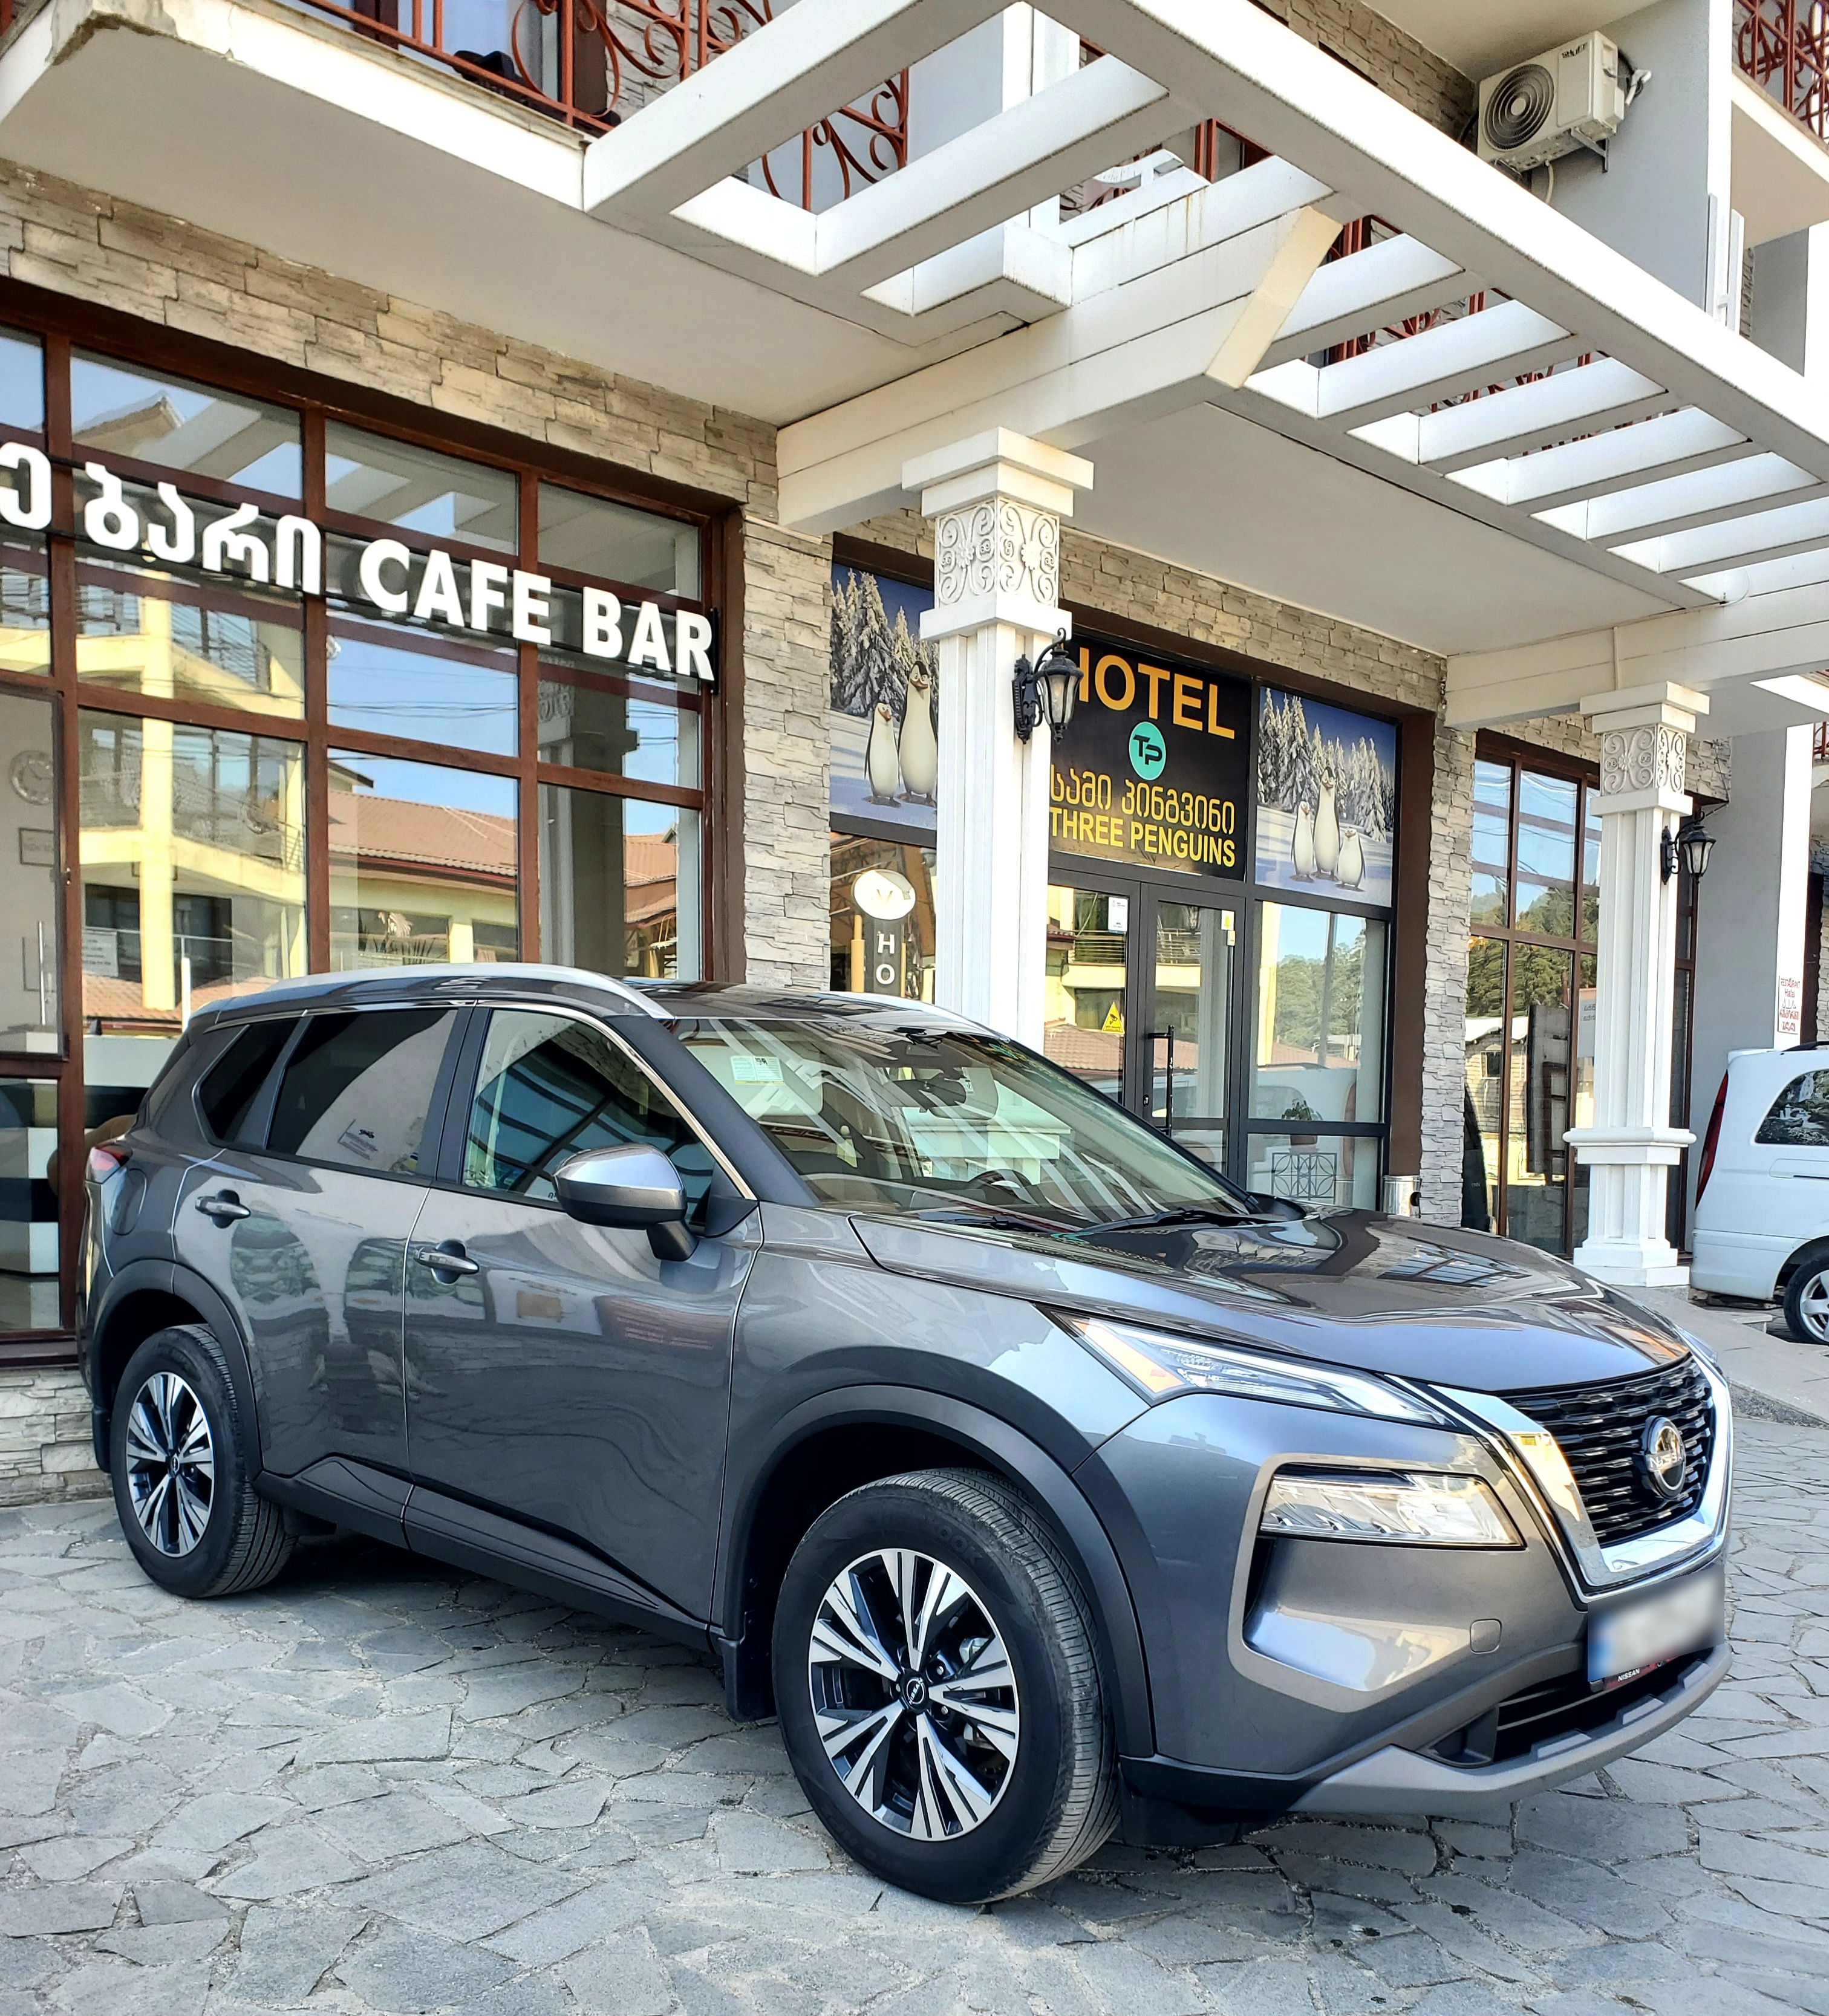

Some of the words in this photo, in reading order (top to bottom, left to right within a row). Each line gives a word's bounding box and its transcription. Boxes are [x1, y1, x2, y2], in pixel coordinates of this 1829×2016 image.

[84, 461, 321, 596] ბარი
[360, 538, 552, 646] CAFE
[582, 586, 715, 681] BAR
[1132, 734, 1163, 765] TP
[1050, 764, 1112, 810] სამი
[1049, 806, 1124, 847] THREE
[1130, 821, 1235, 867] PENGUINS
[1617, 1668, 1640, 1682] NISSAN
